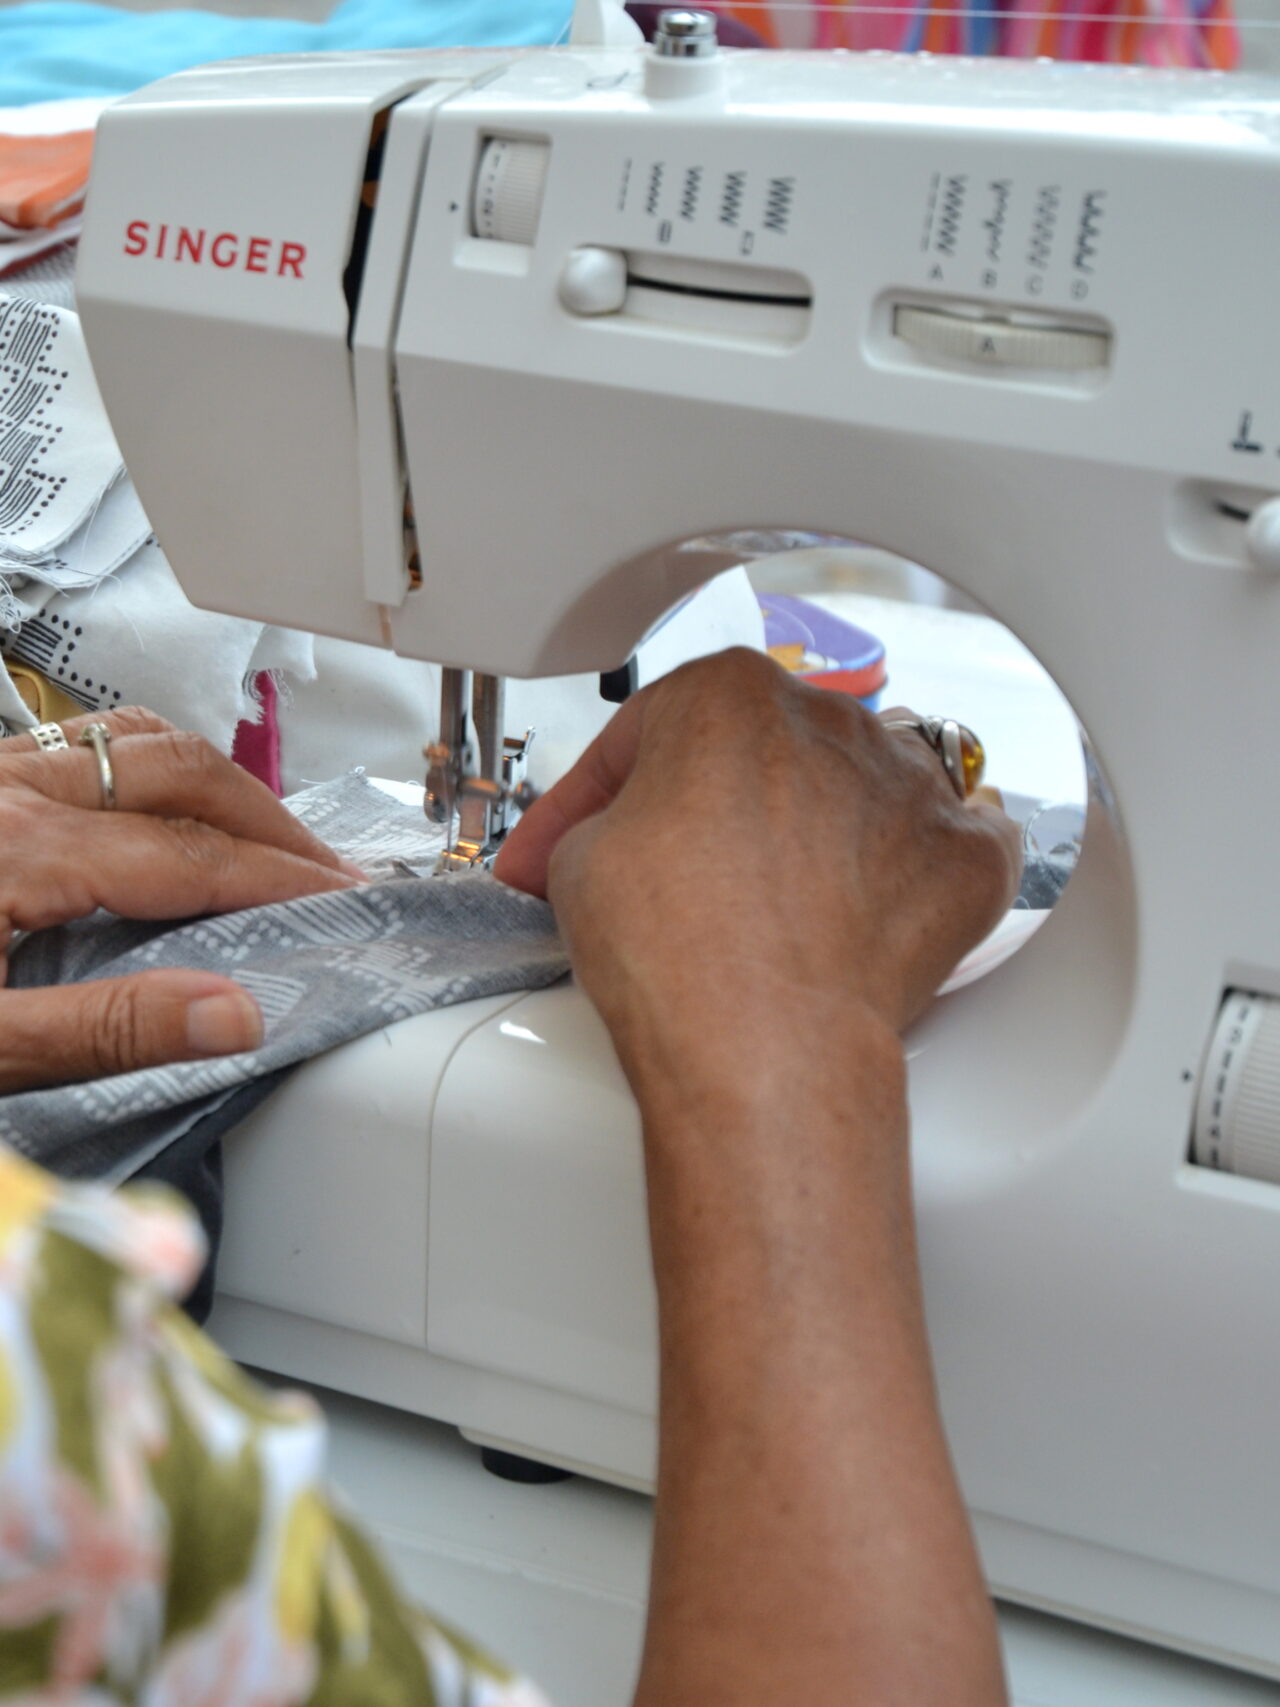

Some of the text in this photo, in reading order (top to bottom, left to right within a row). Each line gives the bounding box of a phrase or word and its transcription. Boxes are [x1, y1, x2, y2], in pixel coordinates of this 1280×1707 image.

[124, 220, 307, 279] SINGER
[928, 263, 944, 282] A
[981, 268, 997, 289] B
[1024, 274, 1044, 296] C
[982, 336, 996, 353] A
